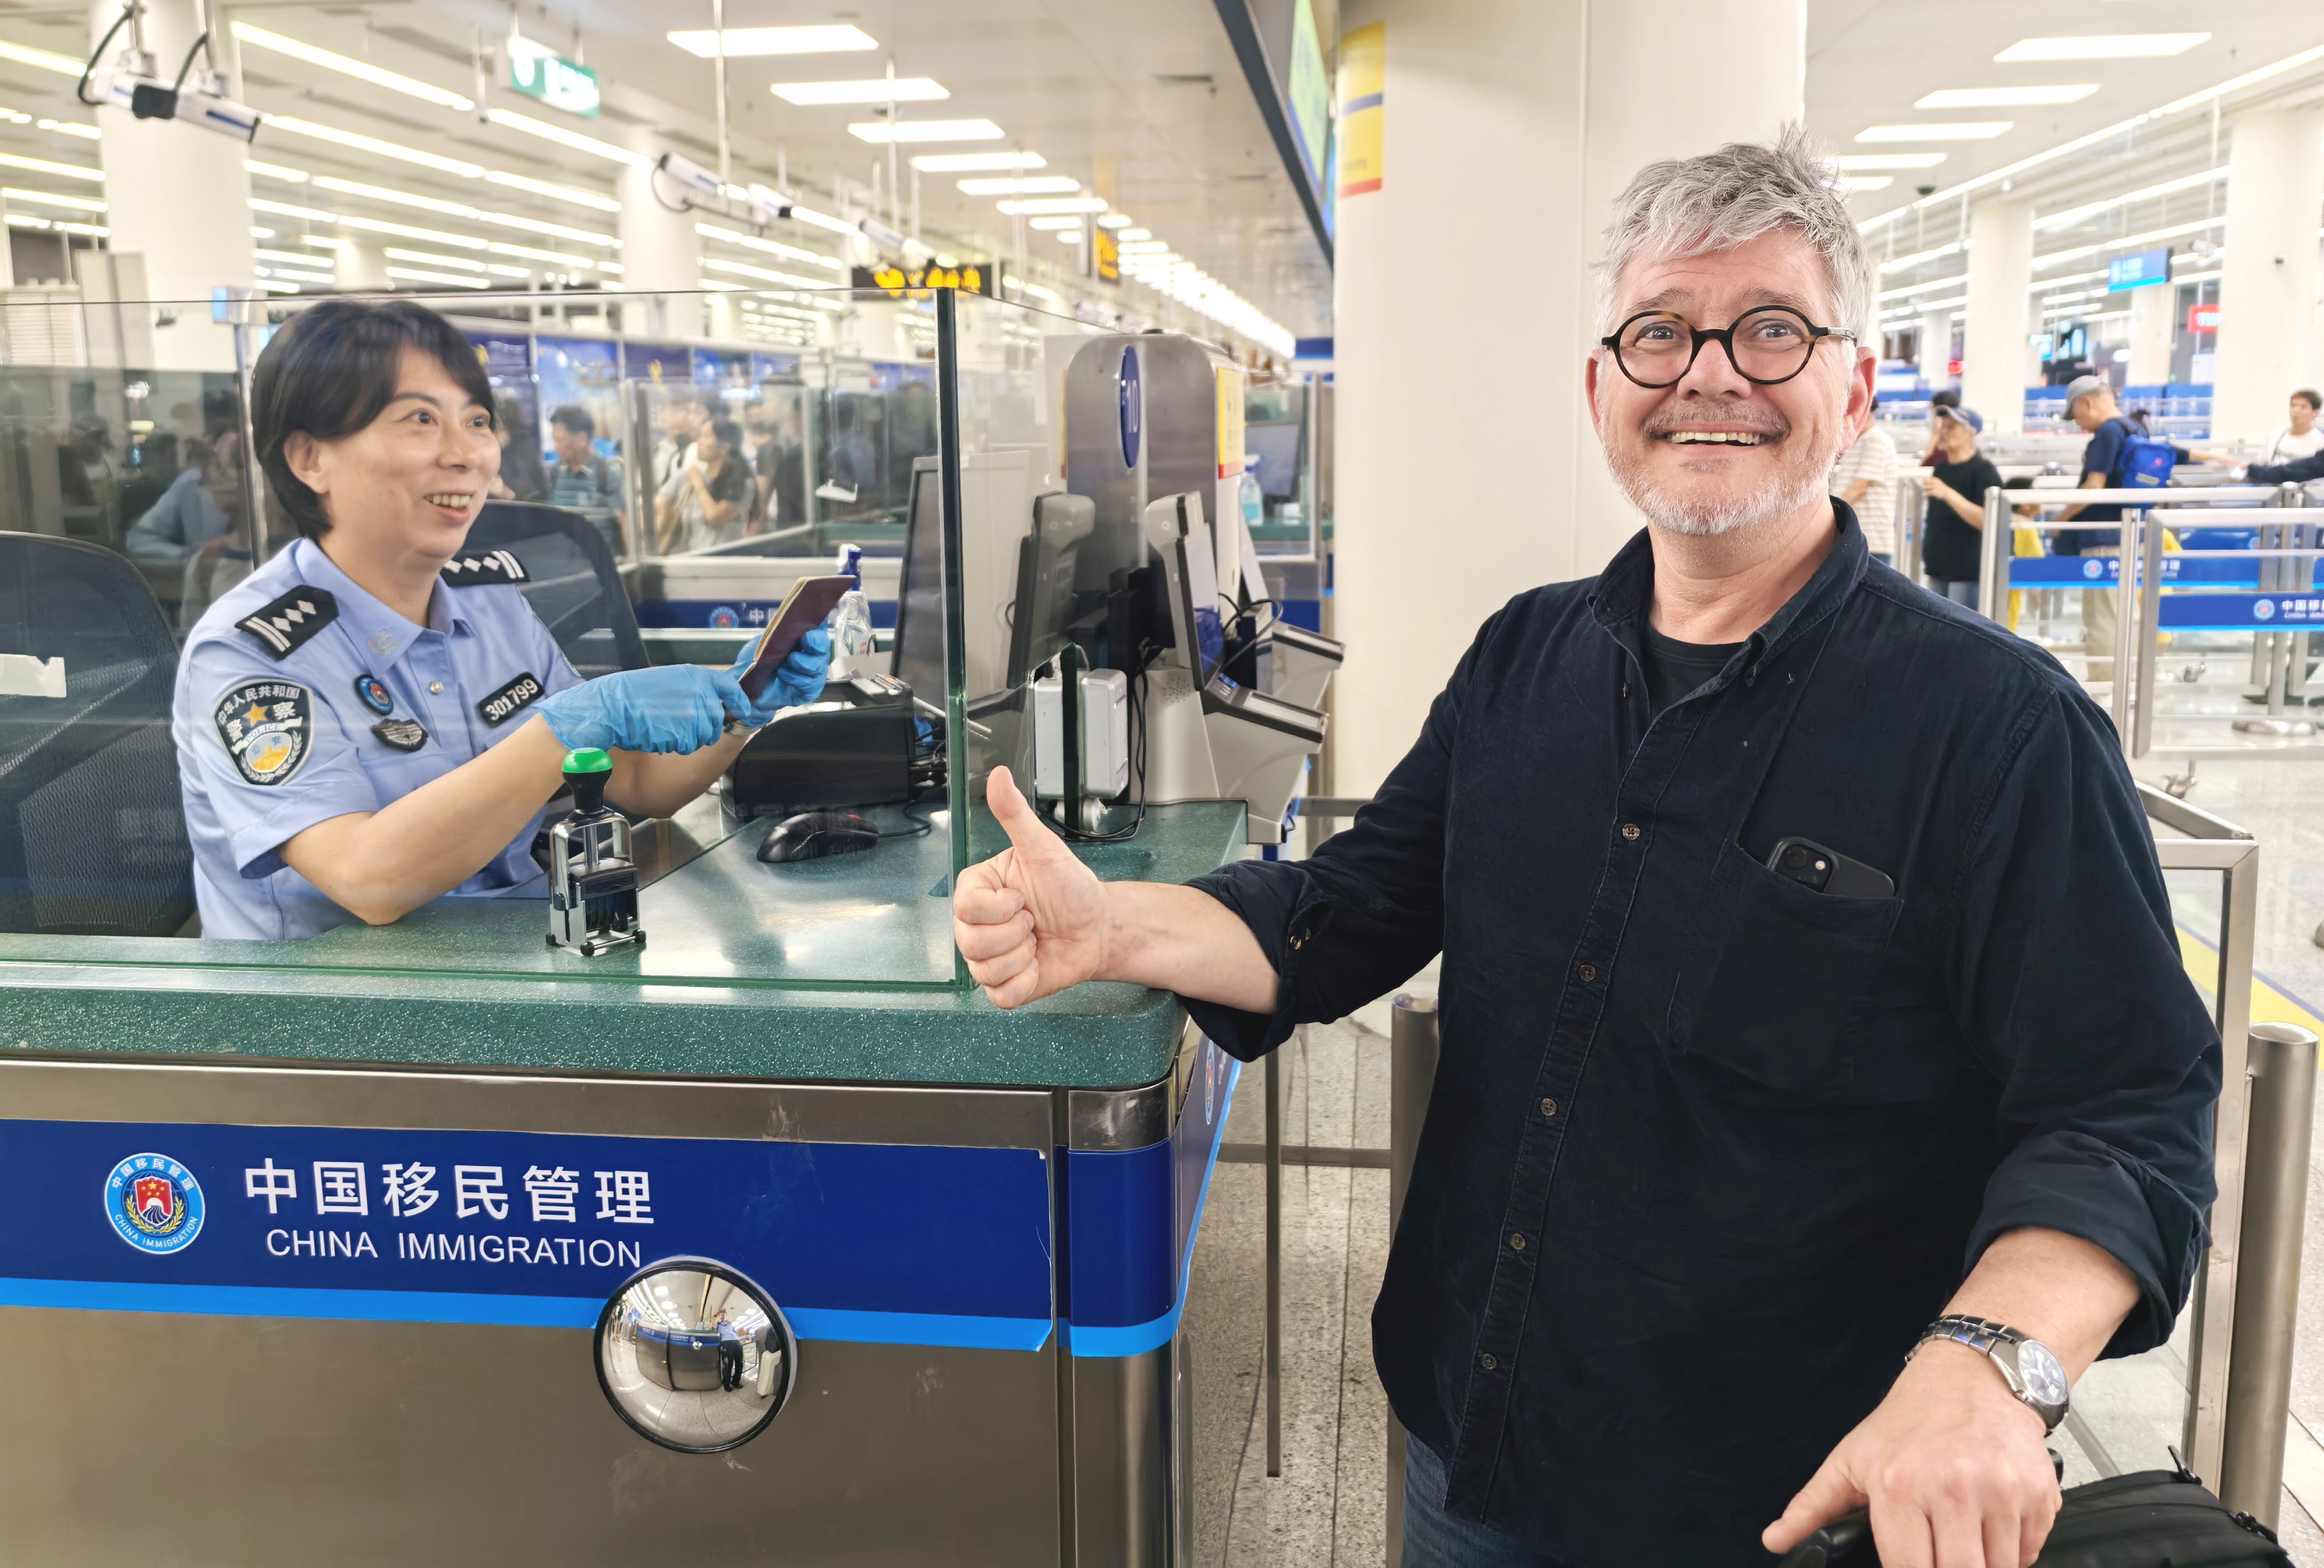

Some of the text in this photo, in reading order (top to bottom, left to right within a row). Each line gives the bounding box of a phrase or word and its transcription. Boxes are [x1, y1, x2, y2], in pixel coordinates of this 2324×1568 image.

[218, 685, 300, 725] 中华人民共和国
[485, 678, 538, 721] 301799
[245, 723, 280, 743] POLICE
[112, 1158, 194, 1191] 中国移民管理
[245, 1158, 654, 1224] 中国移民管理
[115, 1214, 198, 1247] CHINA IMMIGRATION
[267, 1229, 641, 1267] CHINA IMMIGRATION
